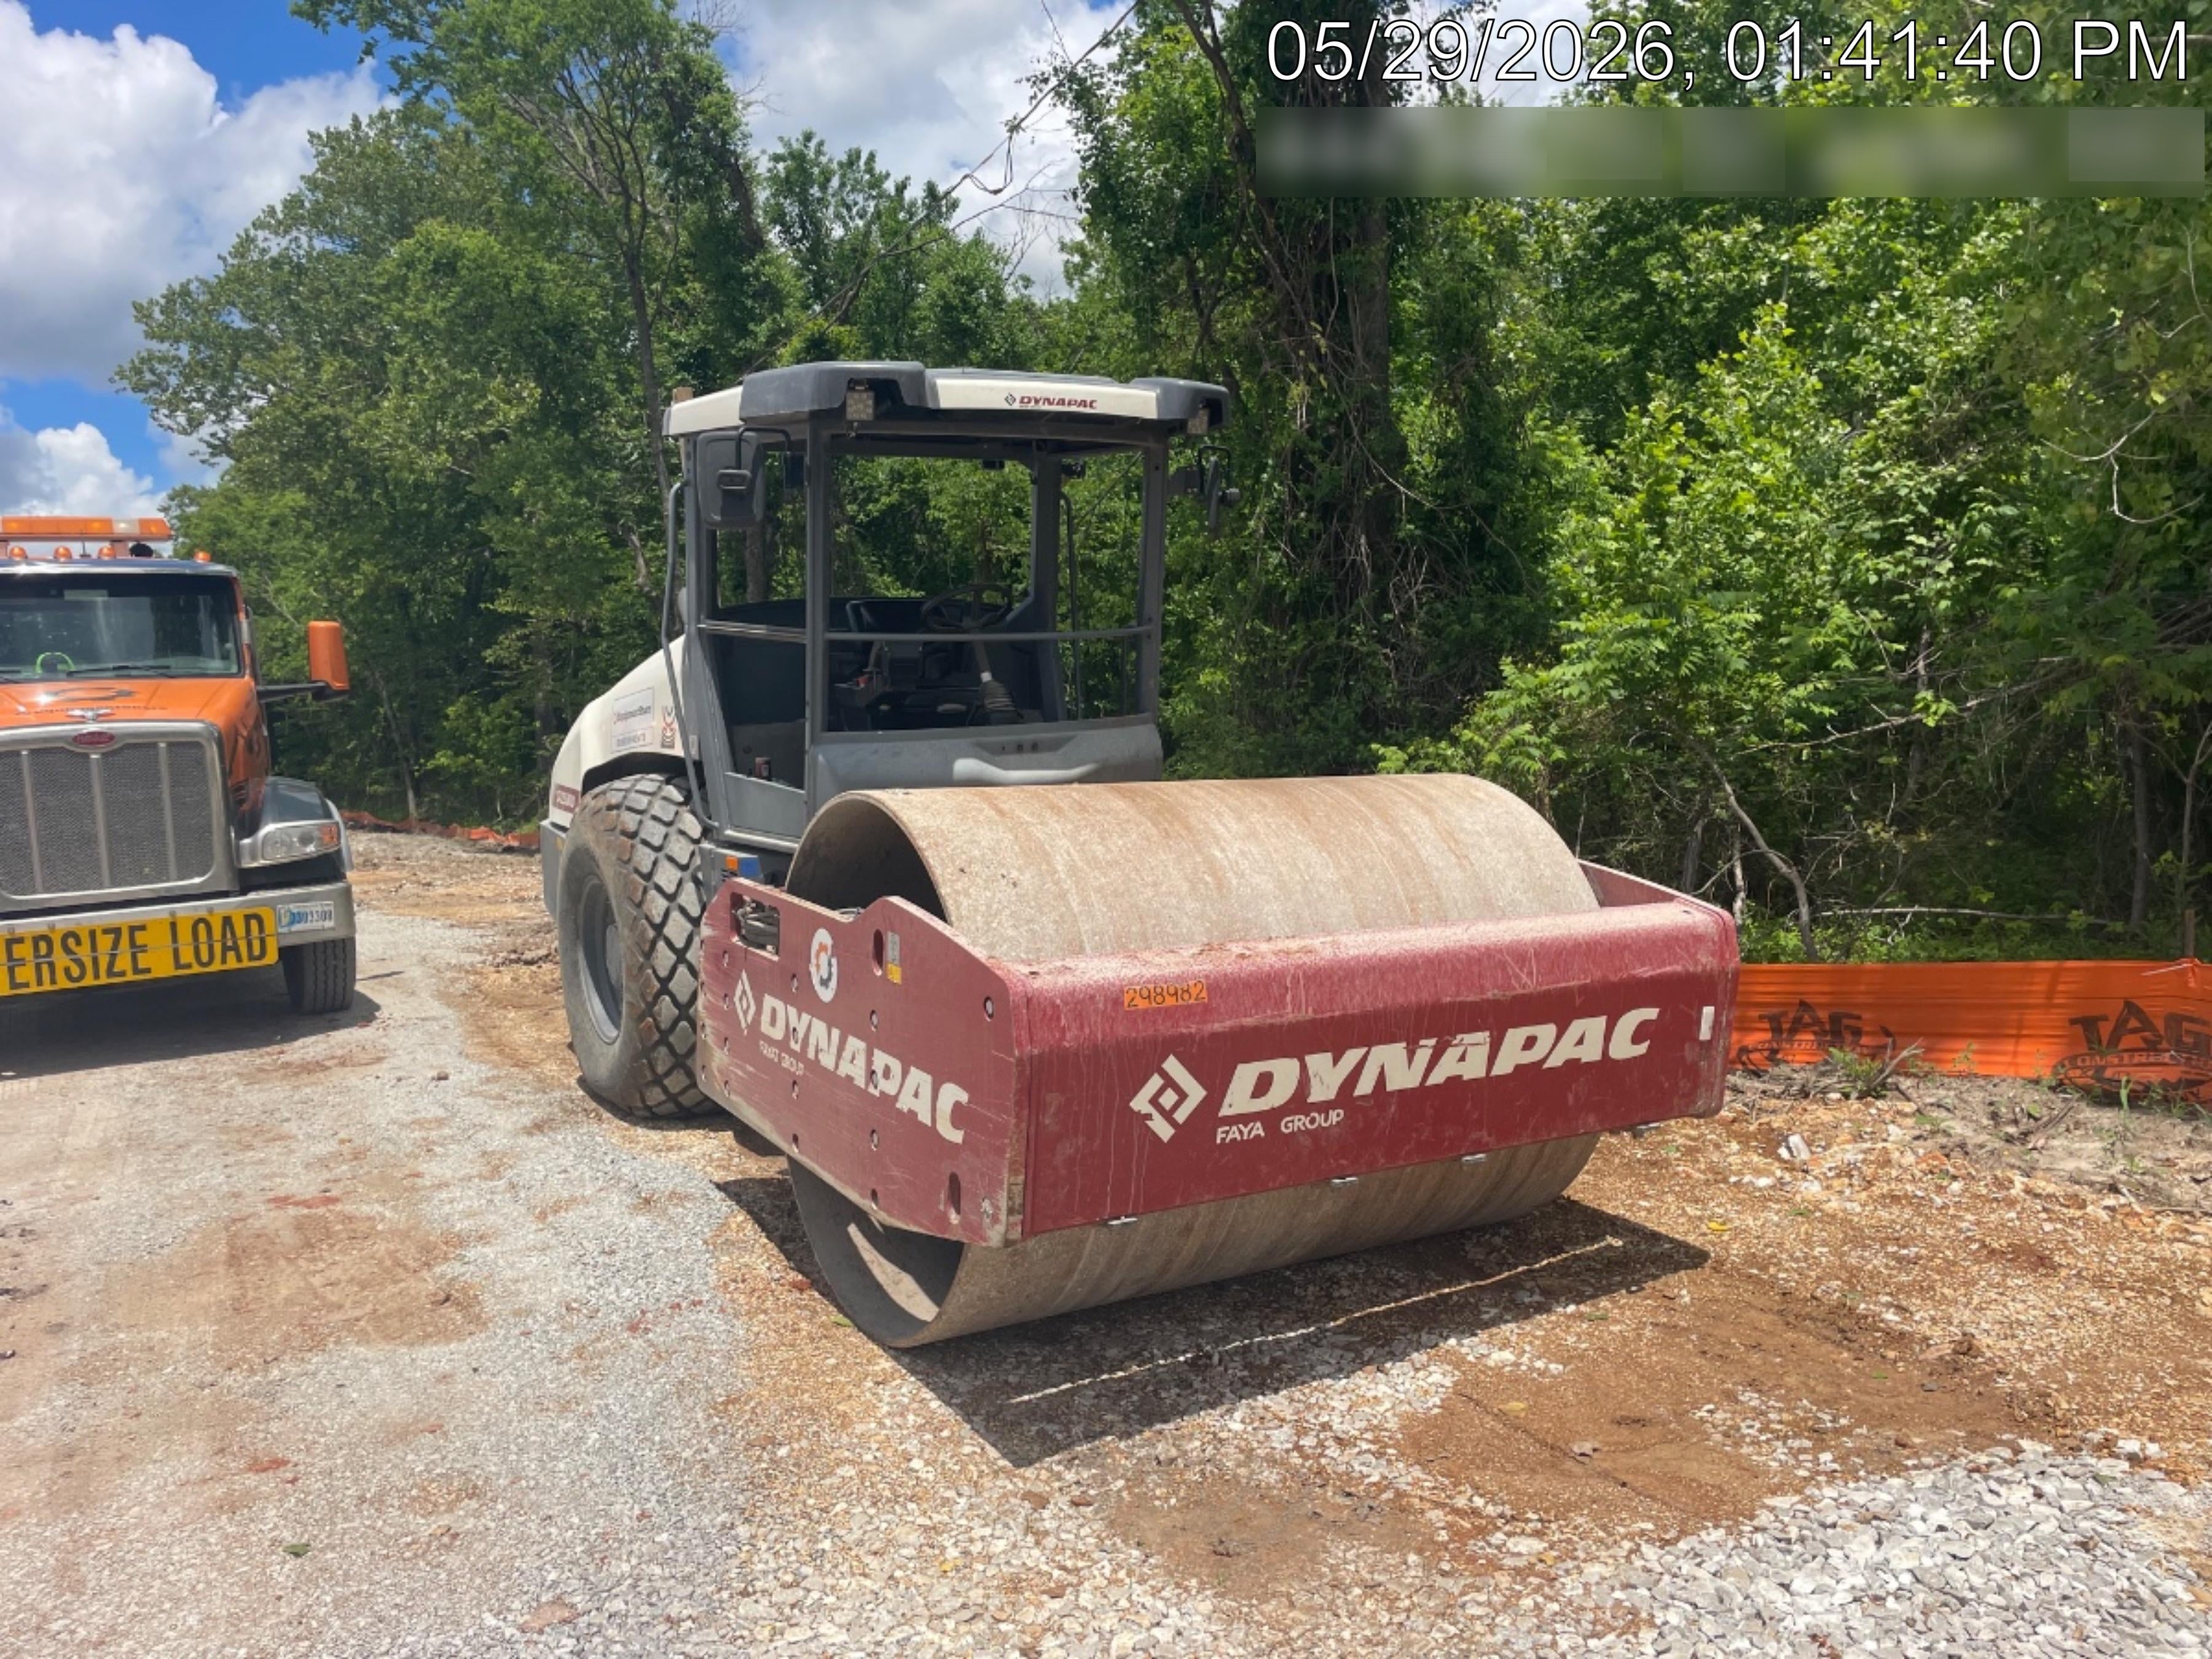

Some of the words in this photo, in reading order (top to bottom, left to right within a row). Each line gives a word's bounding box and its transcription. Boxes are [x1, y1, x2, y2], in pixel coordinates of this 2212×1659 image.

[1019, 395, 1097, 409] DYNAPAC
[169, 913, 268, 971] LOAD
[2068, 1000, 2212, 1057] TAG
[761, 993, 969, 1145] DYNAPAC
[1218, 1008, 1660, 1118] DYNAPAC
[1216, 1121, 1265, 1145] FAYA
[1281, 1108, 1344, 1134] GROUP
